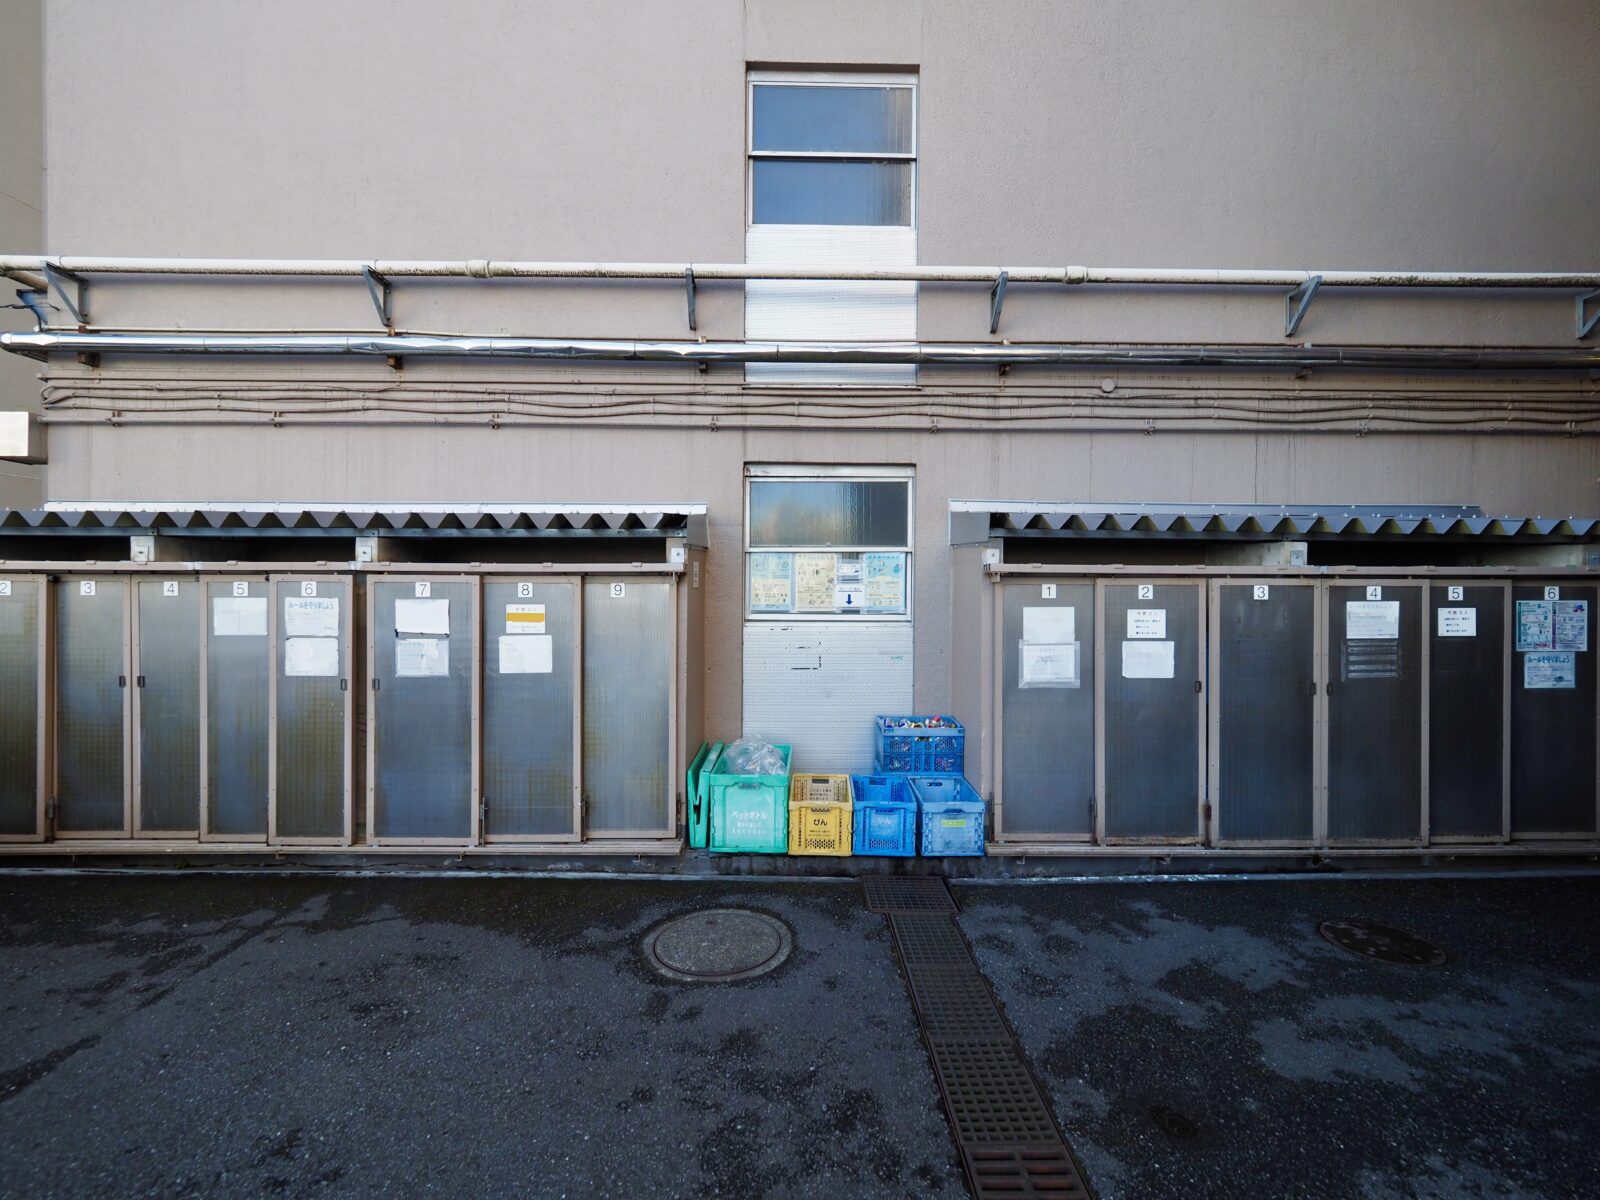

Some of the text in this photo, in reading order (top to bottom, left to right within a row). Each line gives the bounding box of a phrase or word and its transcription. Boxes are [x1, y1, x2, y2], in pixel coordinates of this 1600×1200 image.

[84, 582, 92, 594] 3
[166, 583, 175, 594] 4
[236, 583, 245, 595] 5
[304, 583, 313, 595] 6
[419, 583, 428, 596] 7
[521, 583, 530, 596] 8
[613, 583, 622, 596] 9
[1141, 586, 1150, 598] 2
[1257, 586, 1266, 598] 3
[1369, 587, 1379, 599] 4
[1451, 587, 1461, 600] 5
[1547, 587, 1557, 600] 6
[1527, 655, 1570, 664] ルールを守りましょう
[731, 810, 768, 820] ペットボトル
